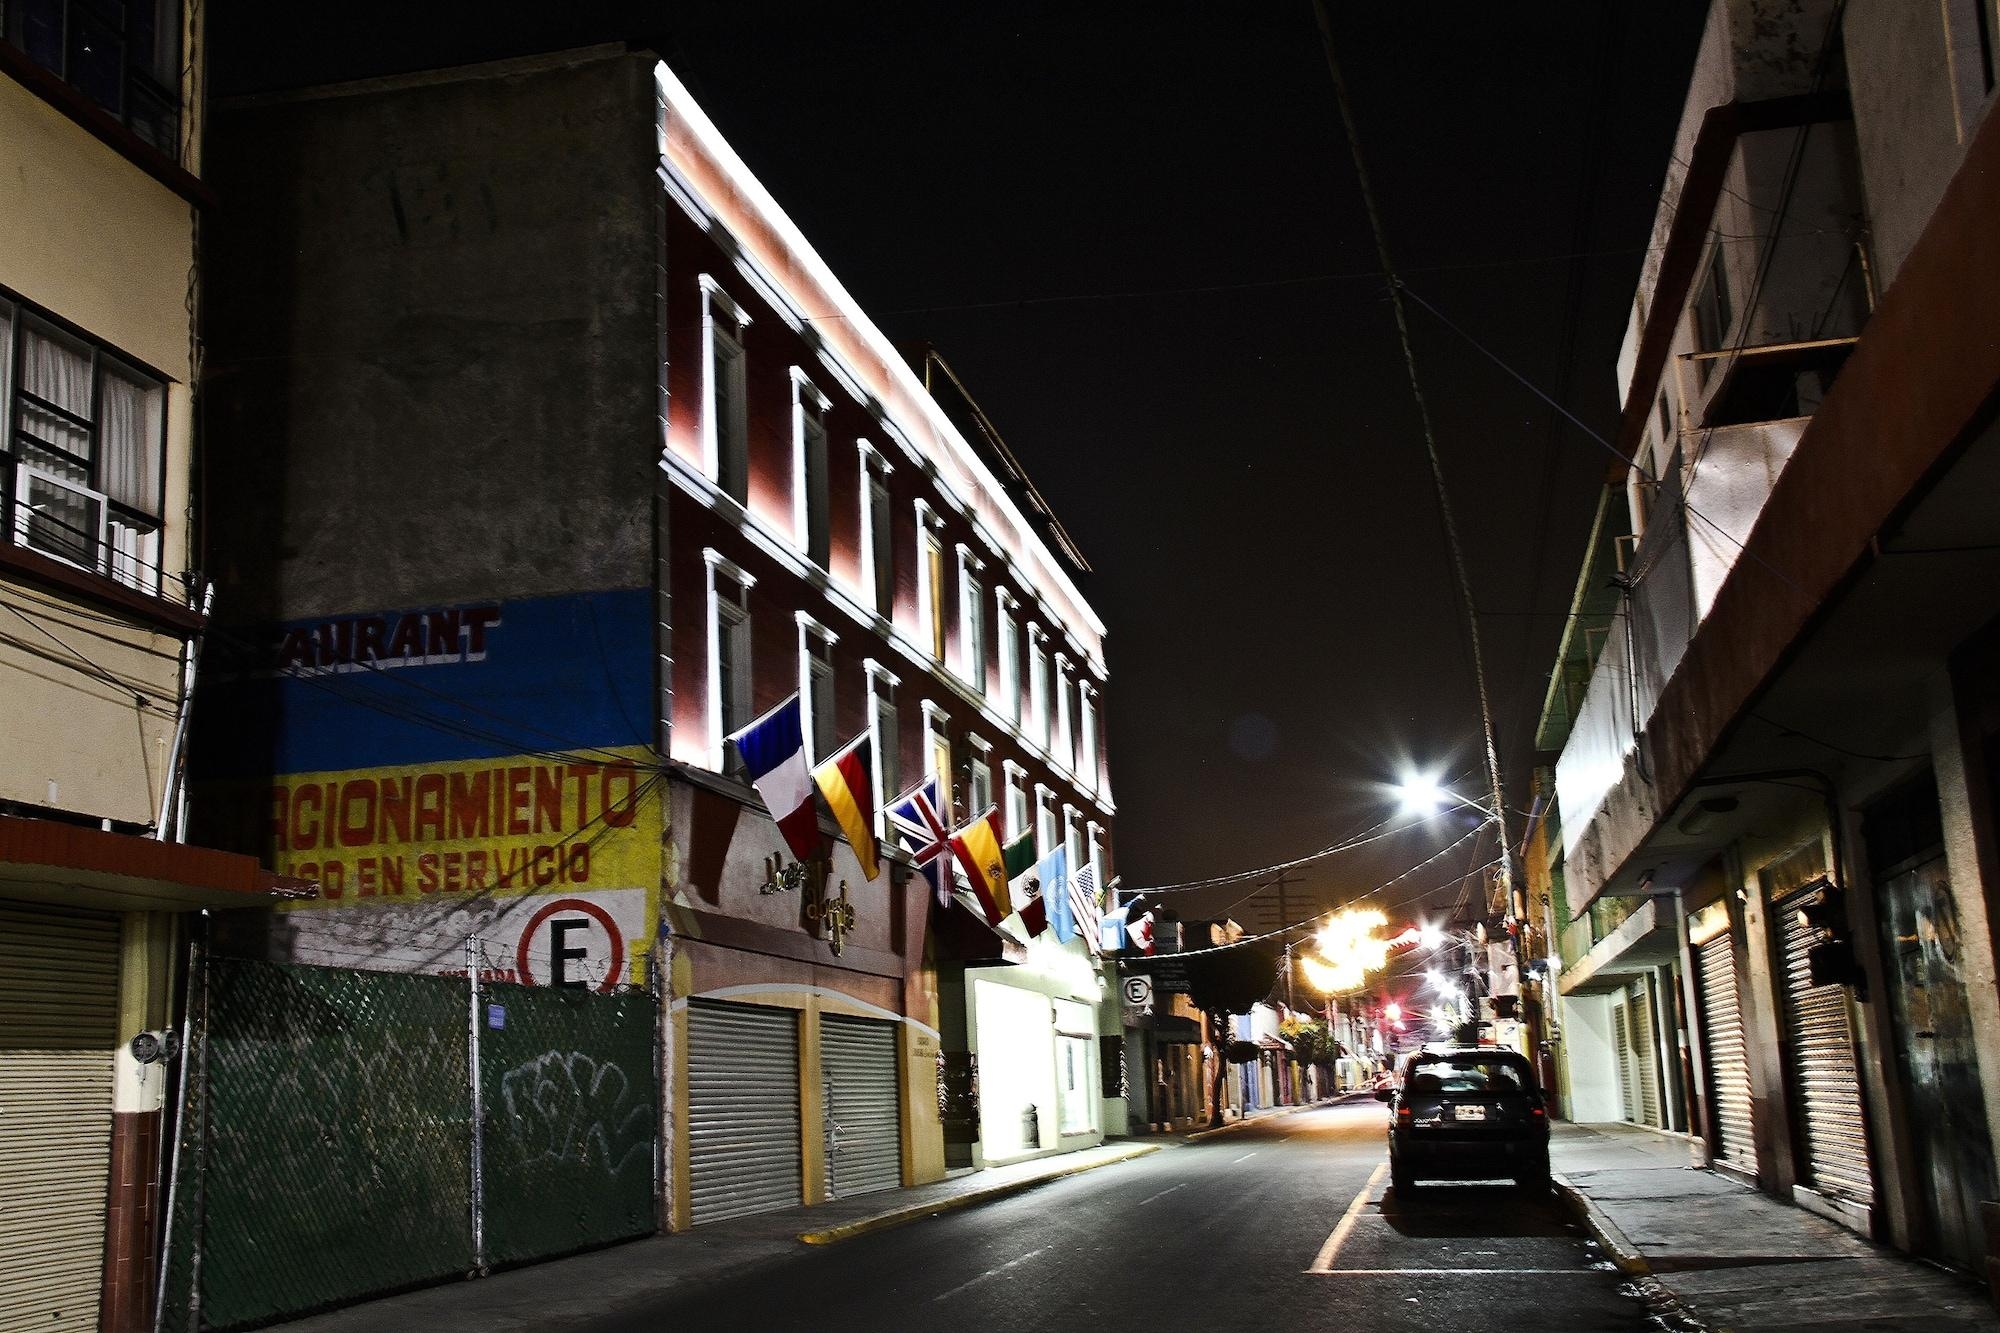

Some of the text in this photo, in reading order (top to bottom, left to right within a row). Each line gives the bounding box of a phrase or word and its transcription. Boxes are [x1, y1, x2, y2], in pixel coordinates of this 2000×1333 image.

[358, 856, 404, 896] EN
[417, 844, 590, 894] SERVICIO
[1131, 983, 1142, 998] E
